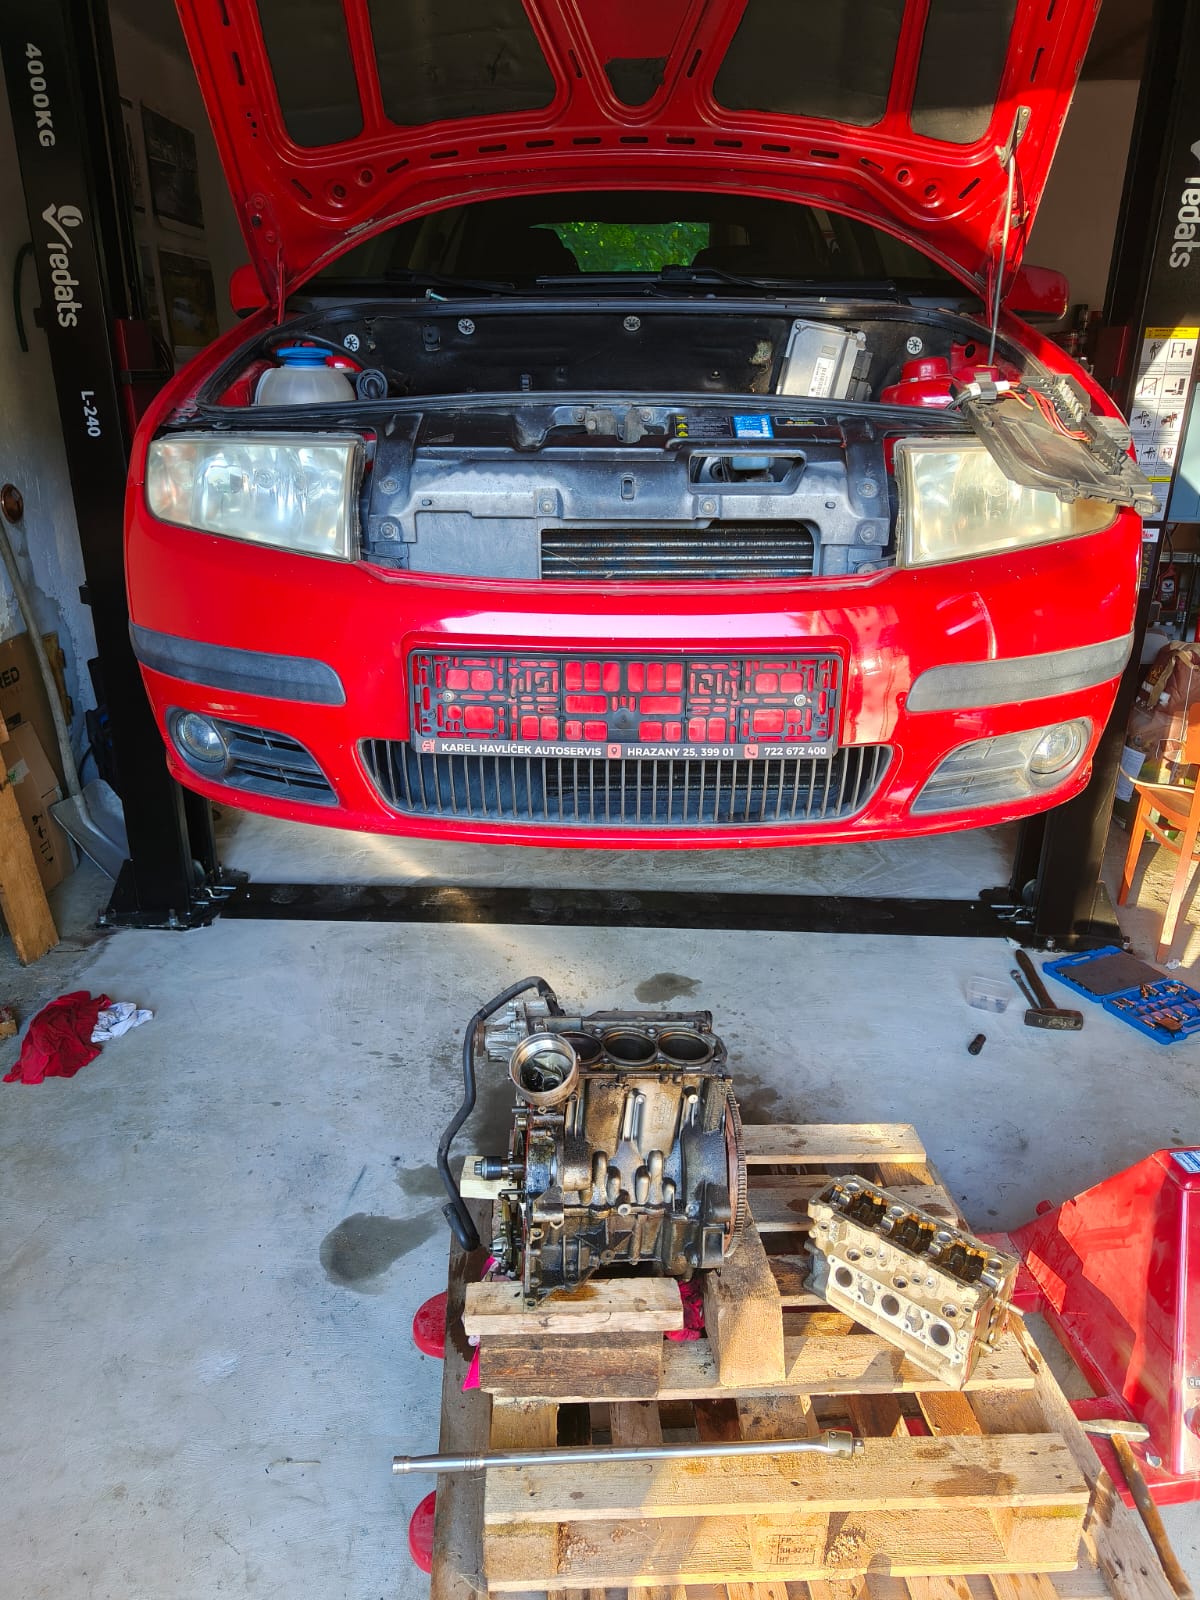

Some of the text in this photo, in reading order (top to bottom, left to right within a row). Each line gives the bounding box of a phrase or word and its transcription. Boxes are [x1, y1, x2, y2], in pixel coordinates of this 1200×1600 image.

[25, 42, 56, 147] 4000KG
[47, 243, 82, 327] redats
[81, 391, 101, 437] L-240
[441, 743, 827, 758] KAREL HAVLÍČEK AUTOSERVIS HRAZANY 25, 399 01 722 672 400
